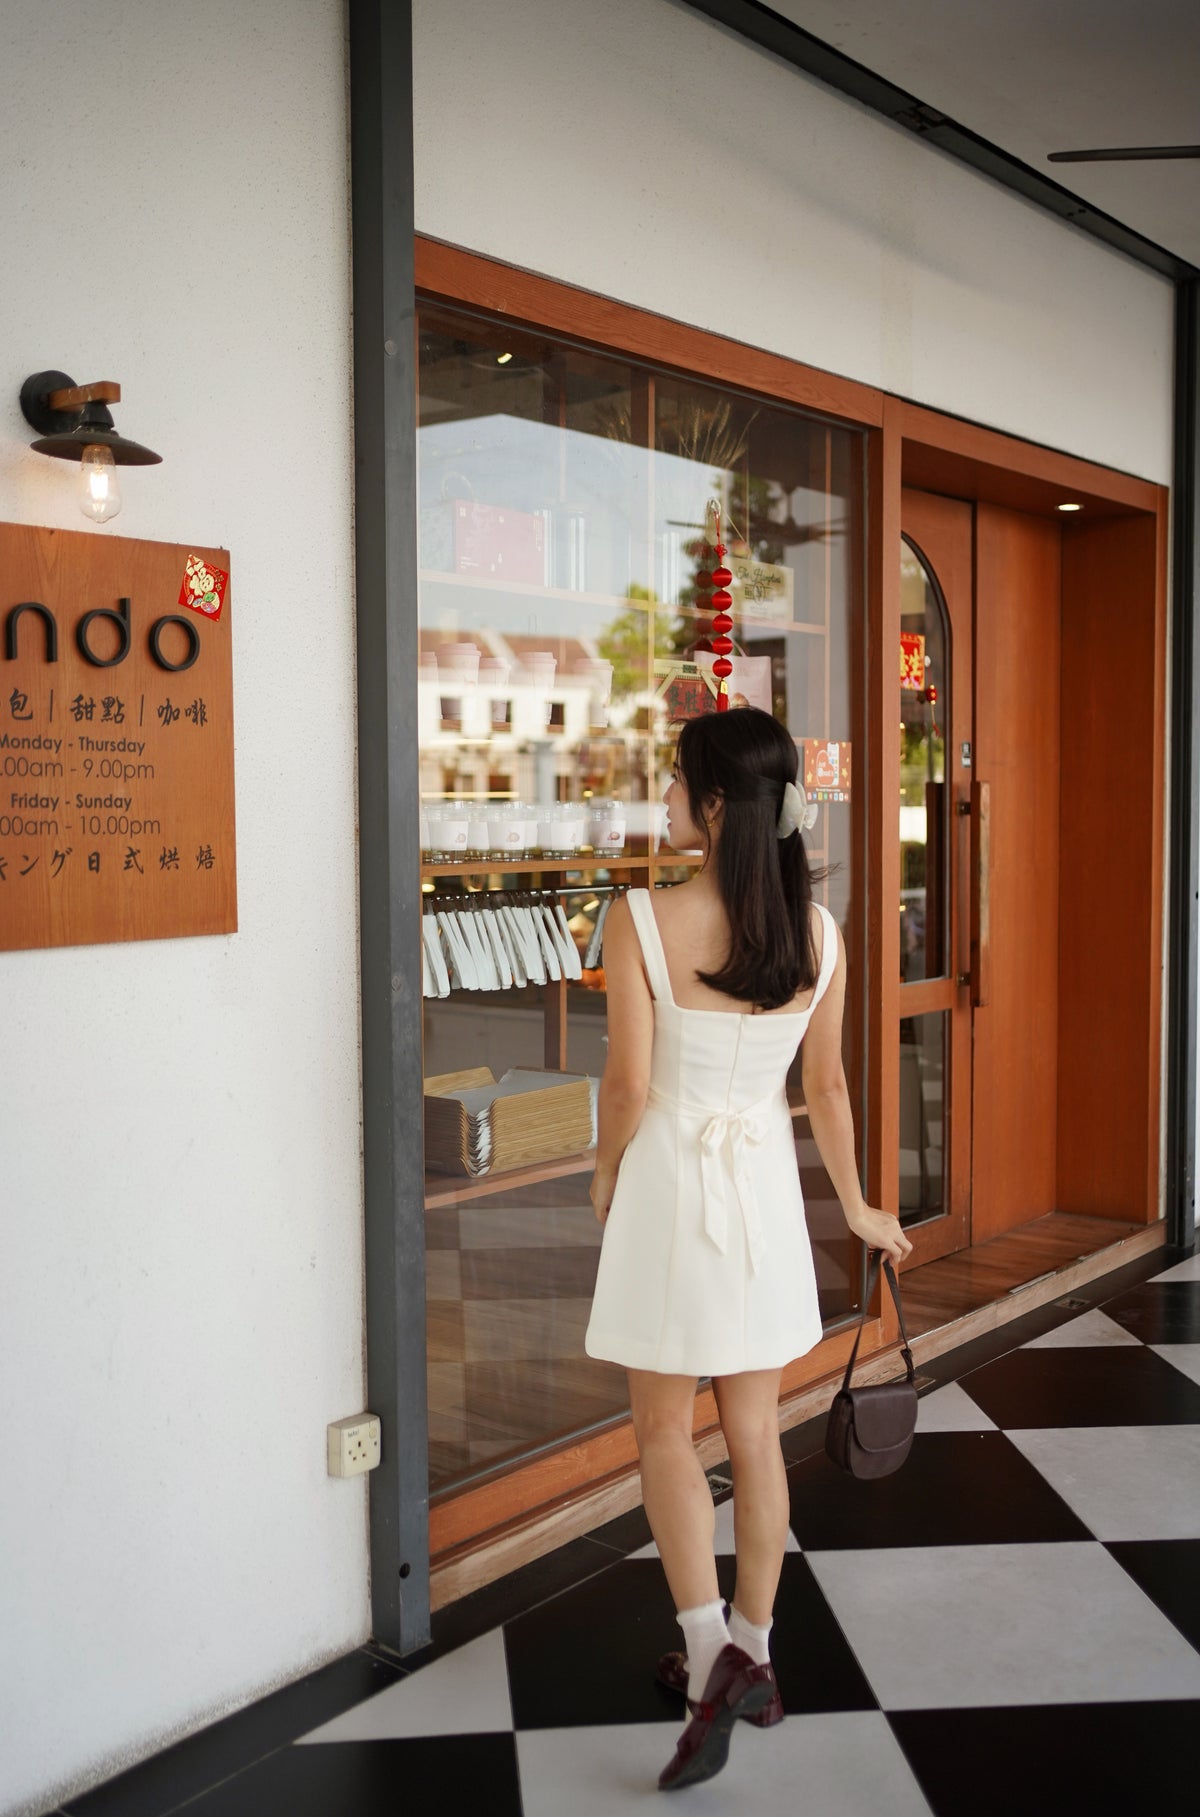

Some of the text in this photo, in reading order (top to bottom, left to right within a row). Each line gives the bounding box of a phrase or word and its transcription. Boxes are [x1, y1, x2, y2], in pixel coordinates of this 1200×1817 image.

[70, 693, 125, 724] 甜點
[157, 697, 208, 727] 咖啡
[79, 736, 146, 757] Thursday
[83, 758, 155, 783] 9.00pm
[11, 793, 60, 812] Friday
[76, 793, 132, 812] Sunday
[80, 815, 161, 839] 10.00pm
